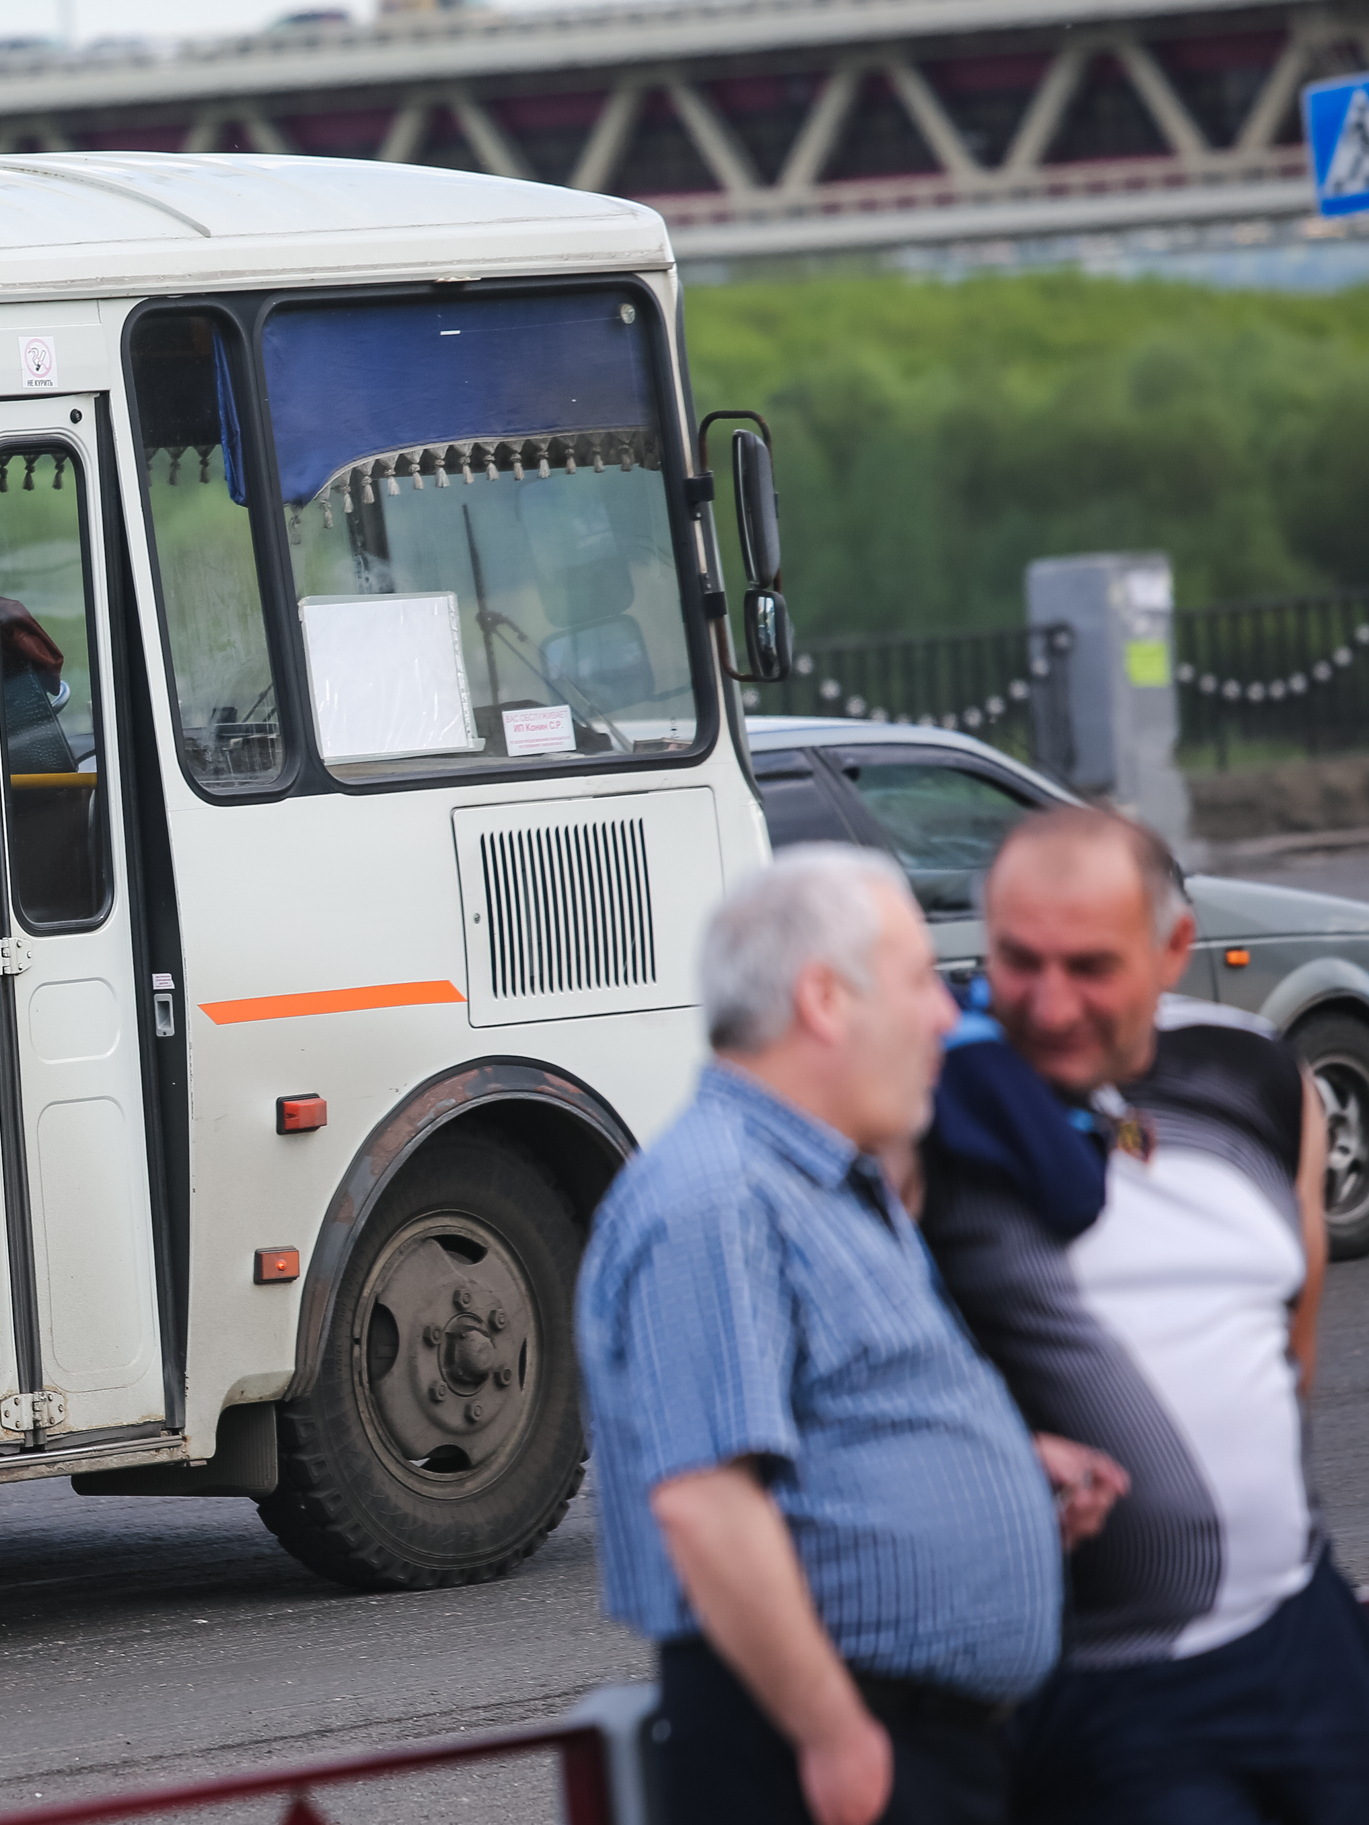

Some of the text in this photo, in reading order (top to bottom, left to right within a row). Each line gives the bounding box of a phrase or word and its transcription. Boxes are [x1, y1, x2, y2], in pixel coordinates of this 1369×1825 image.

[26, 379, 54, 387] НЕ КУРИТЬ
[505, 710, 569, 724] ВАС ОБСЛУЖИВАЕТ
[513, 723, 524, 733] ИП
